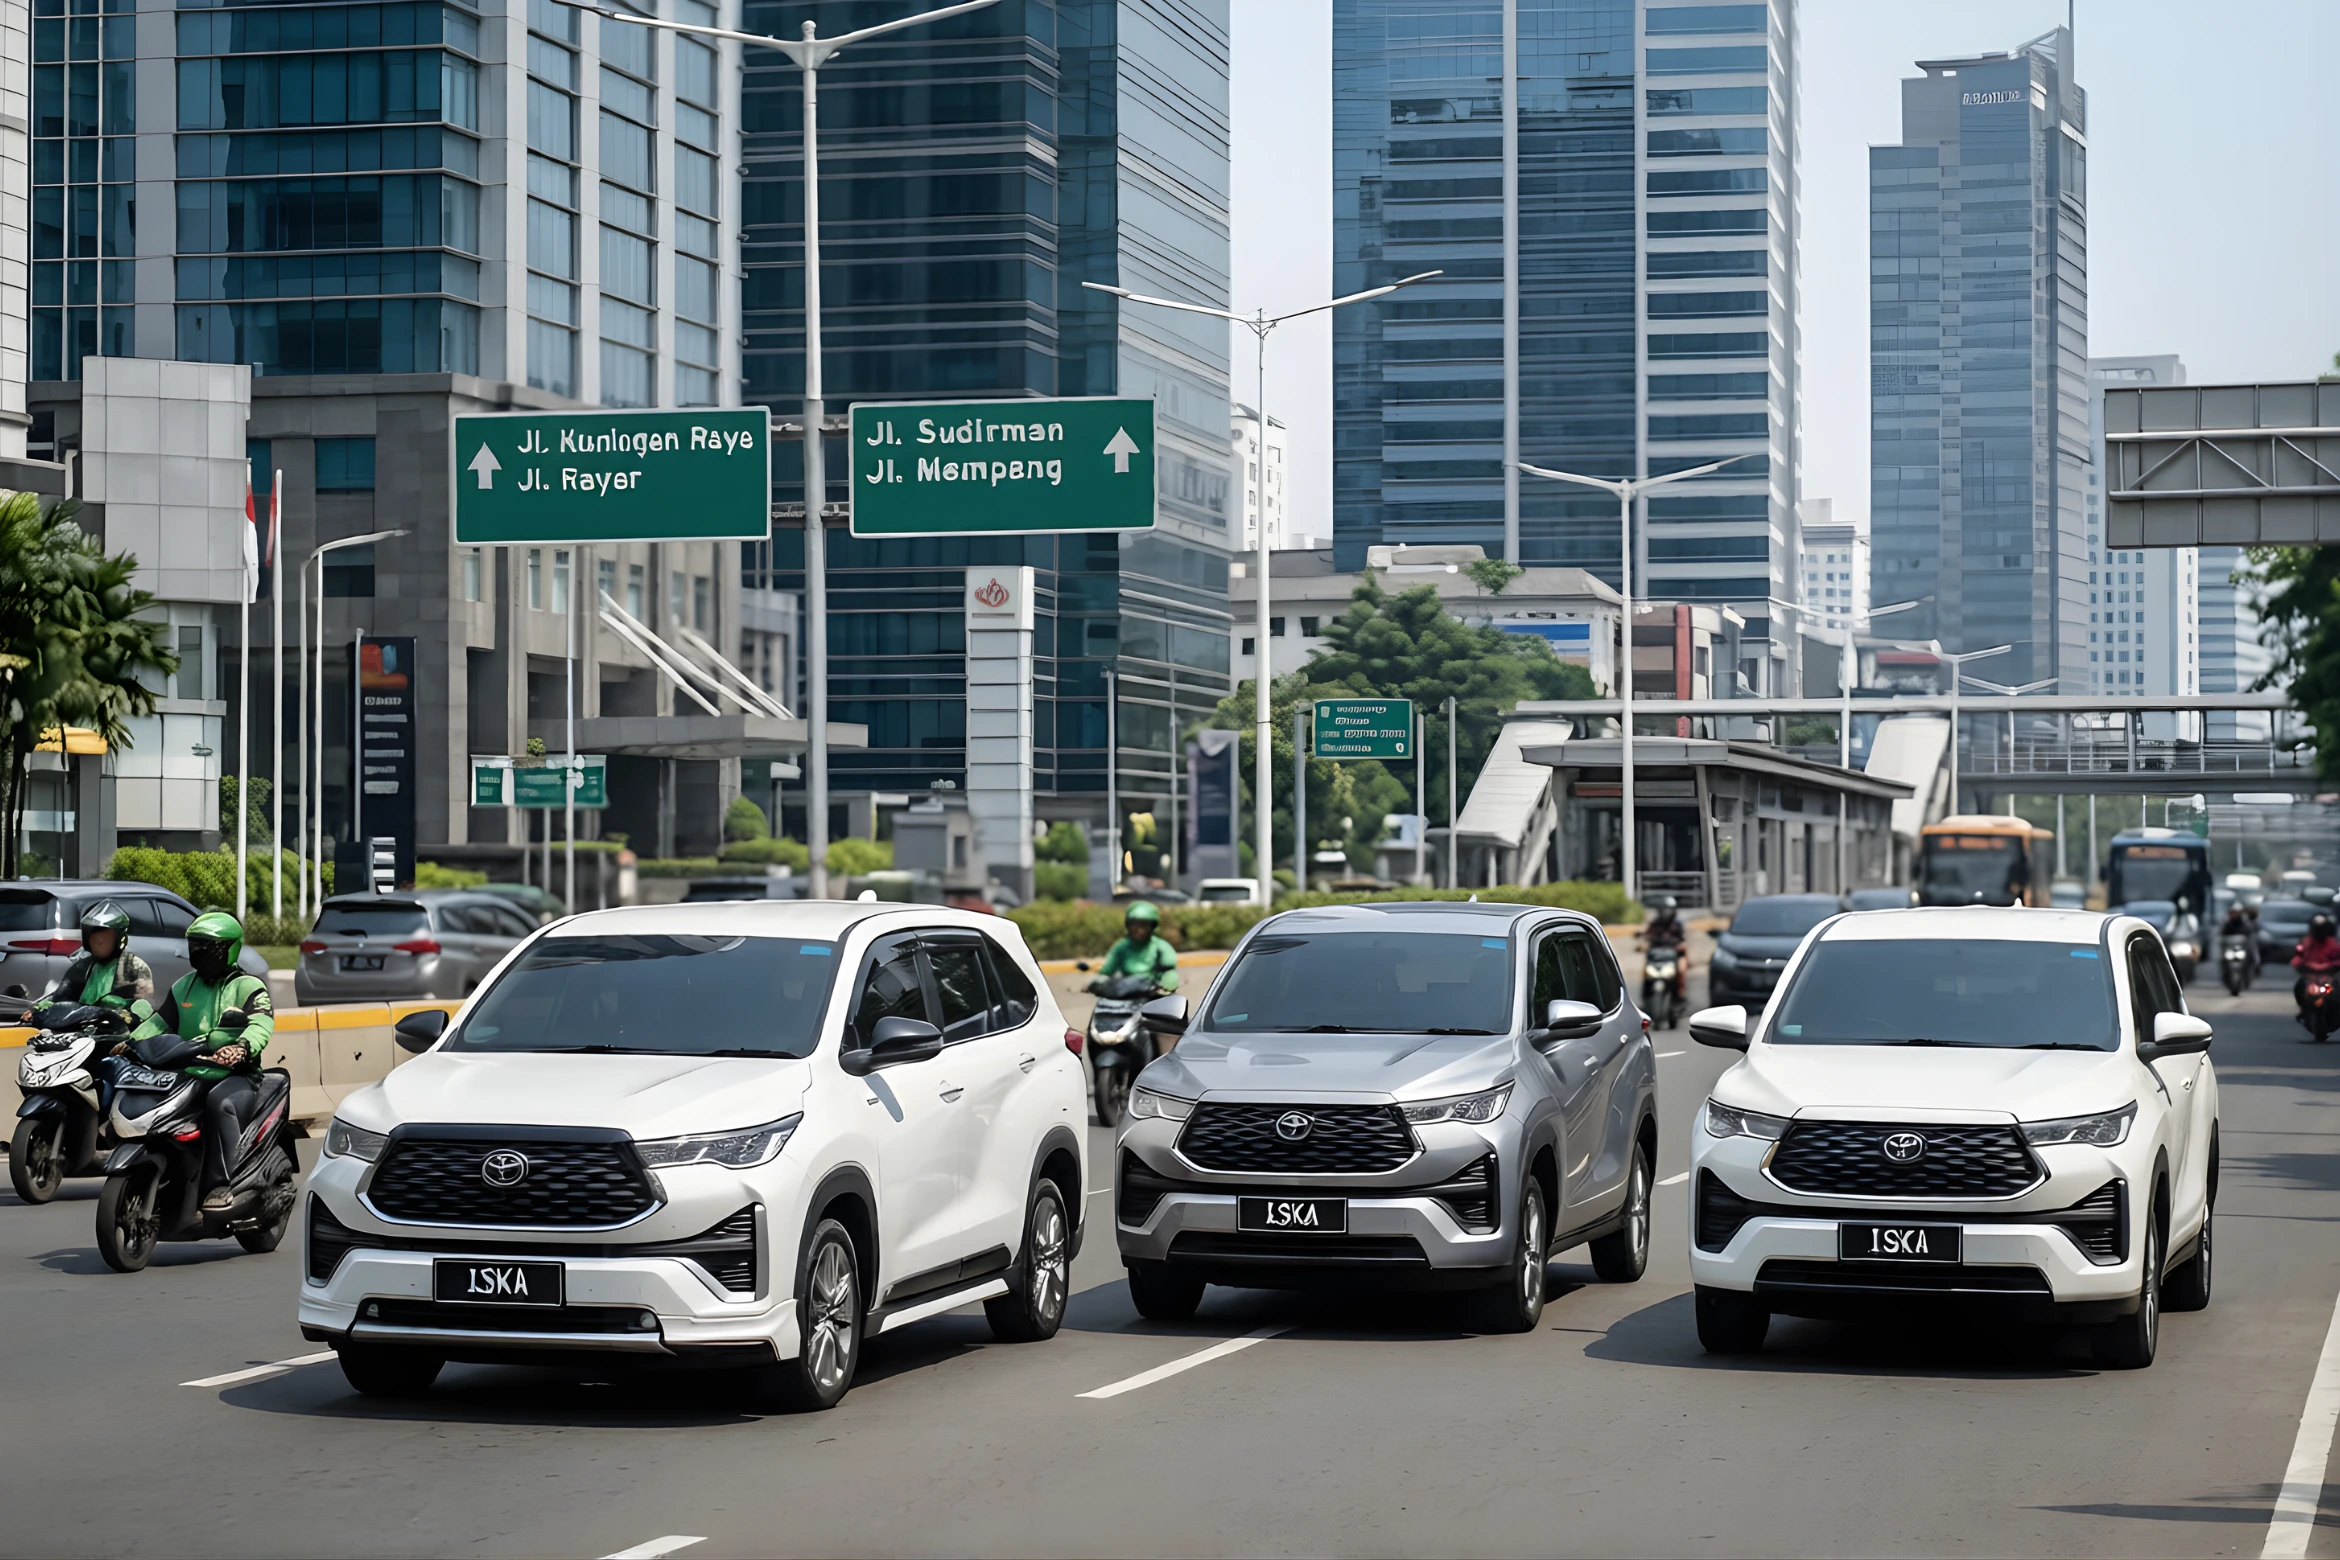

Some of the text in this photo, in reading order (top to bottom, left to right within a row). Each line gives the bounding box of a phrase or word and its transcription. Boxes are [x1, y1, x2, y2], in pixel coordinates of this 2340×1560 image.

[866, 421, 902, 446] Jl.
[517, 468, 550, 491] Jl.
[866, 459, 902, 484] Jl.
[467, 1267, 529, 1296] ISKA
